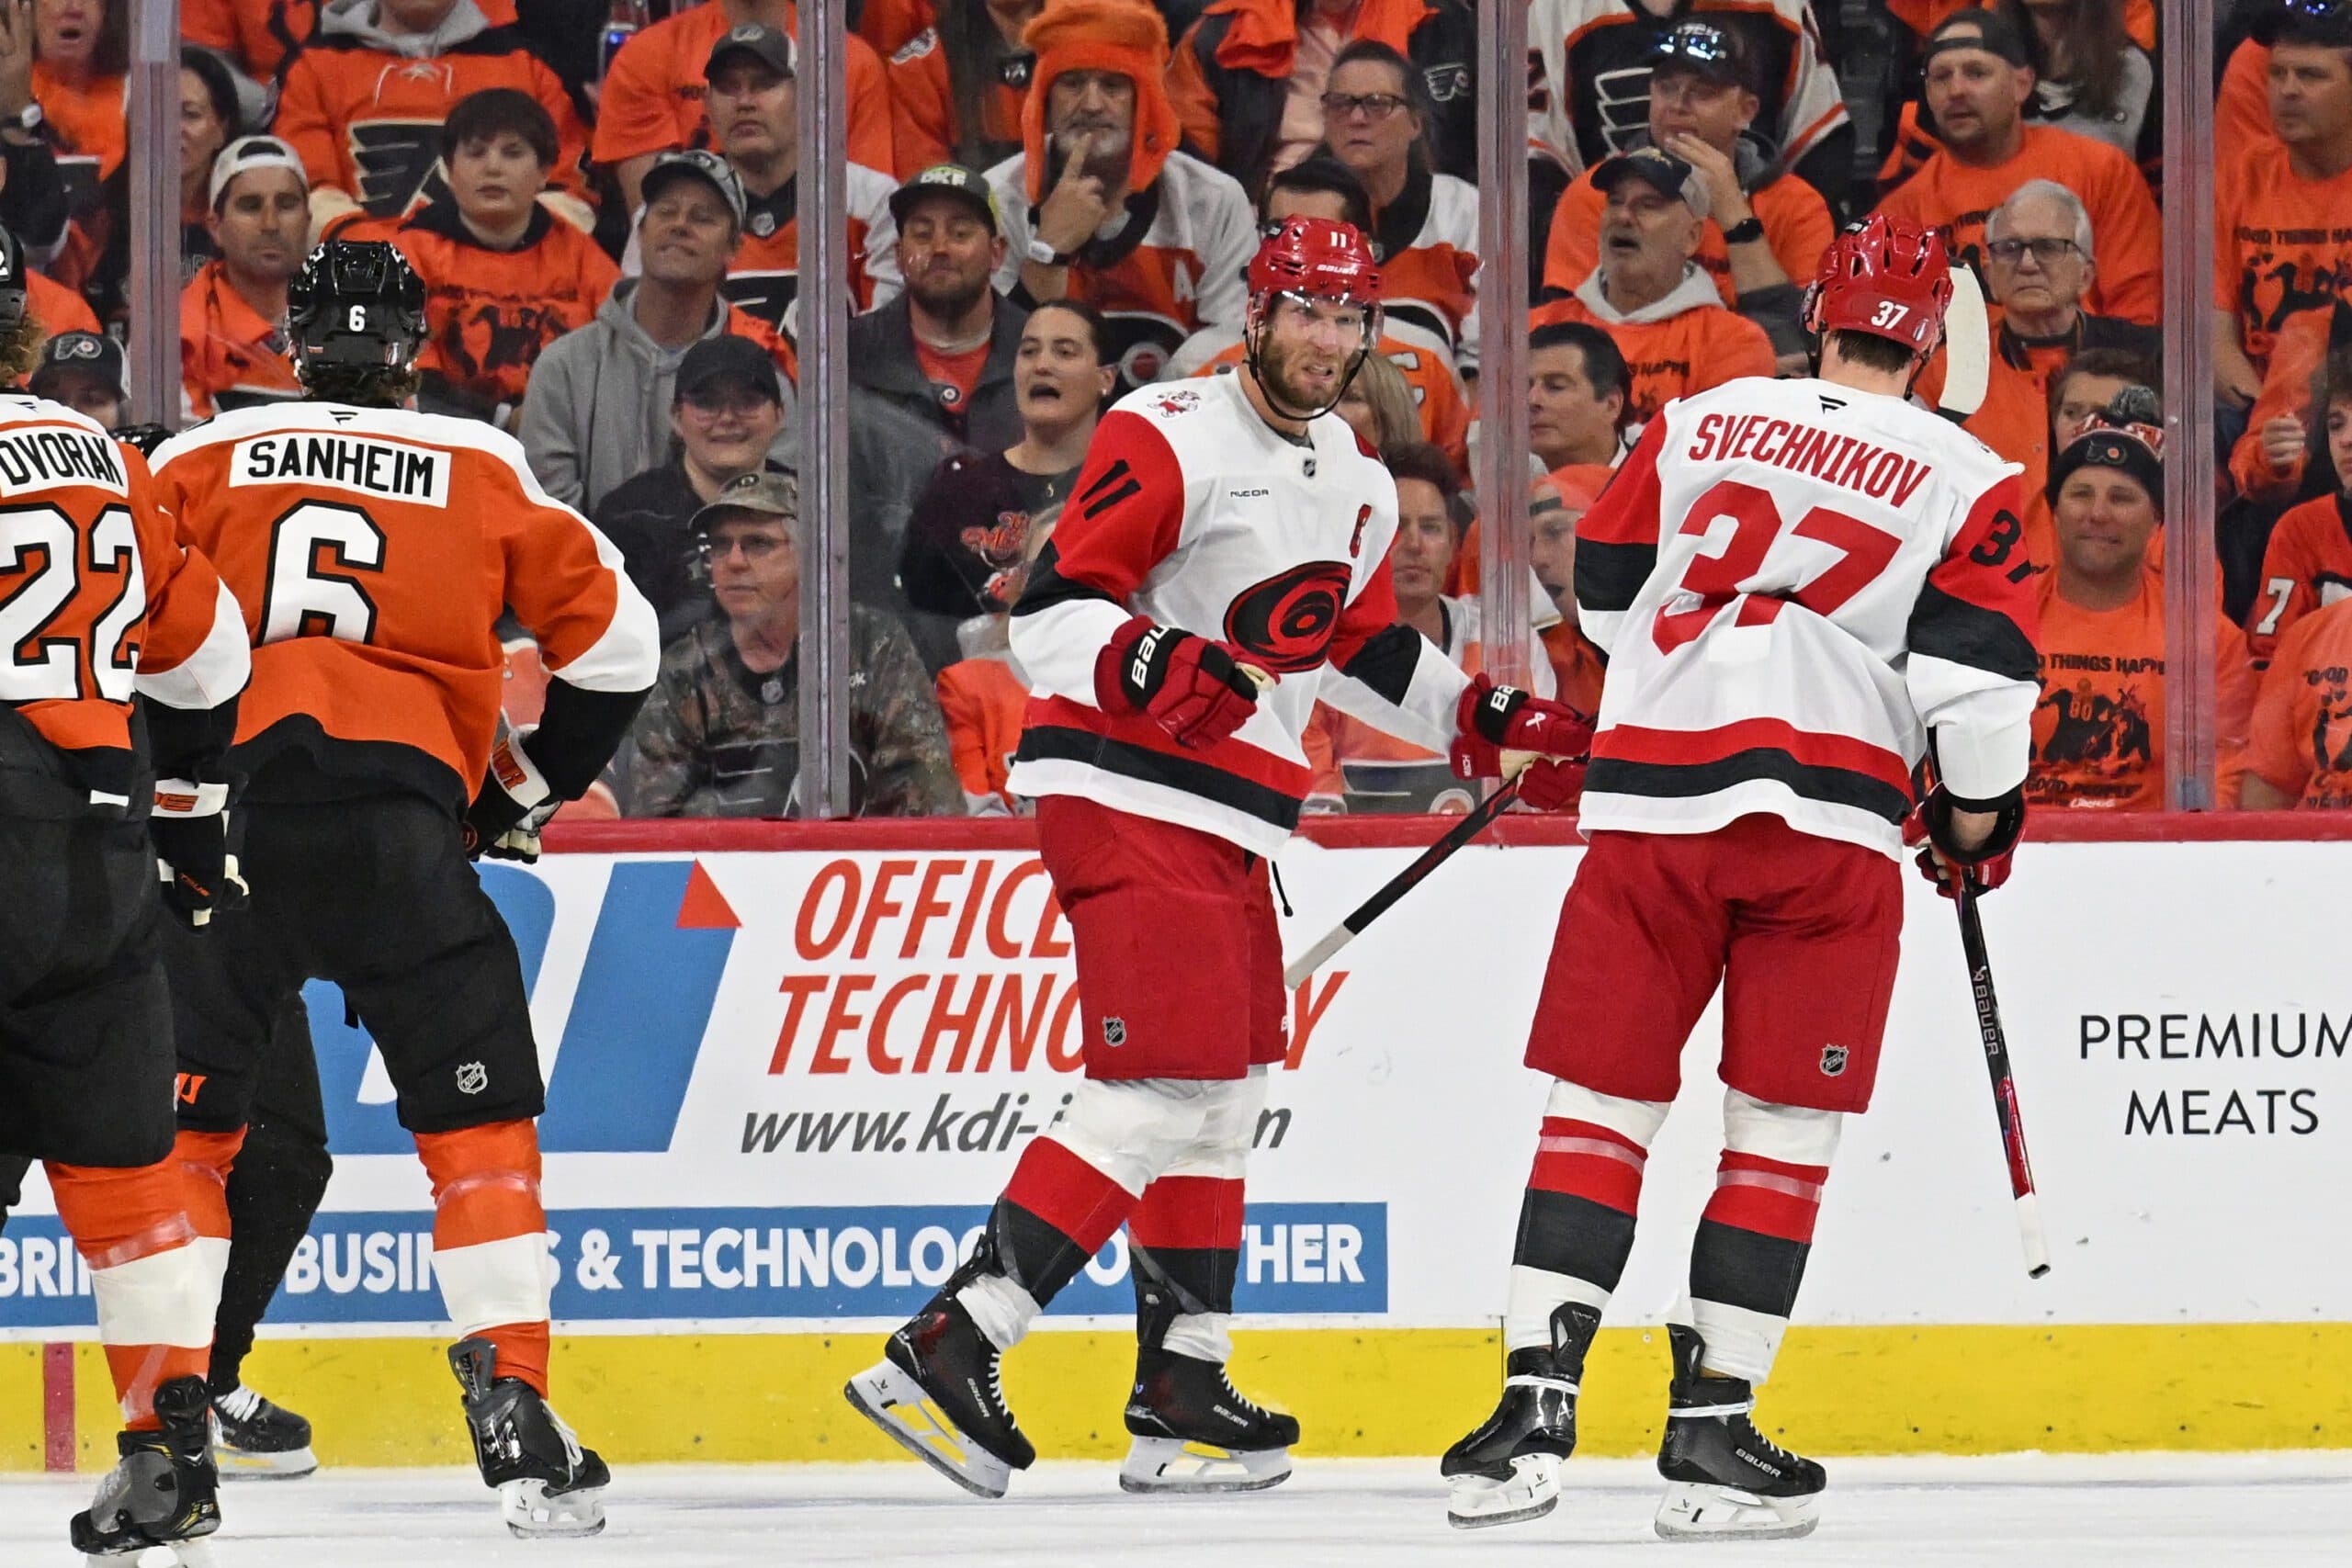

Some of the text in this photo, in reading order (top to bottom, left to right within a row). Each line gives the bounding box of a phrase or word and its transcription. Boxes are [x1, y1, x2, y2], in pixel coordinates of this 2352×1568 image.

[1330, 231, 1347, 248] 11
[348, 305, 366, 333] 6
[1871, 300, 1910, 330] 37
[0, 432, 124, 487] DVORAK
[247, 437, 435, 498] SANHEIM
[1079, 458, 1143, 522] 11
[1688, 412, 1932, 509] SVECHNIKOV
[257, 496, 388, 648] 6
[1652, 479, 1904, 657] 37
[0, 500, 147, 705] 22
[2079, 1012, 2352, 1060] PREMIUM
[2123, 1088, 2320, 1136] MEATS
[575, 1228, 624, 1292] &
